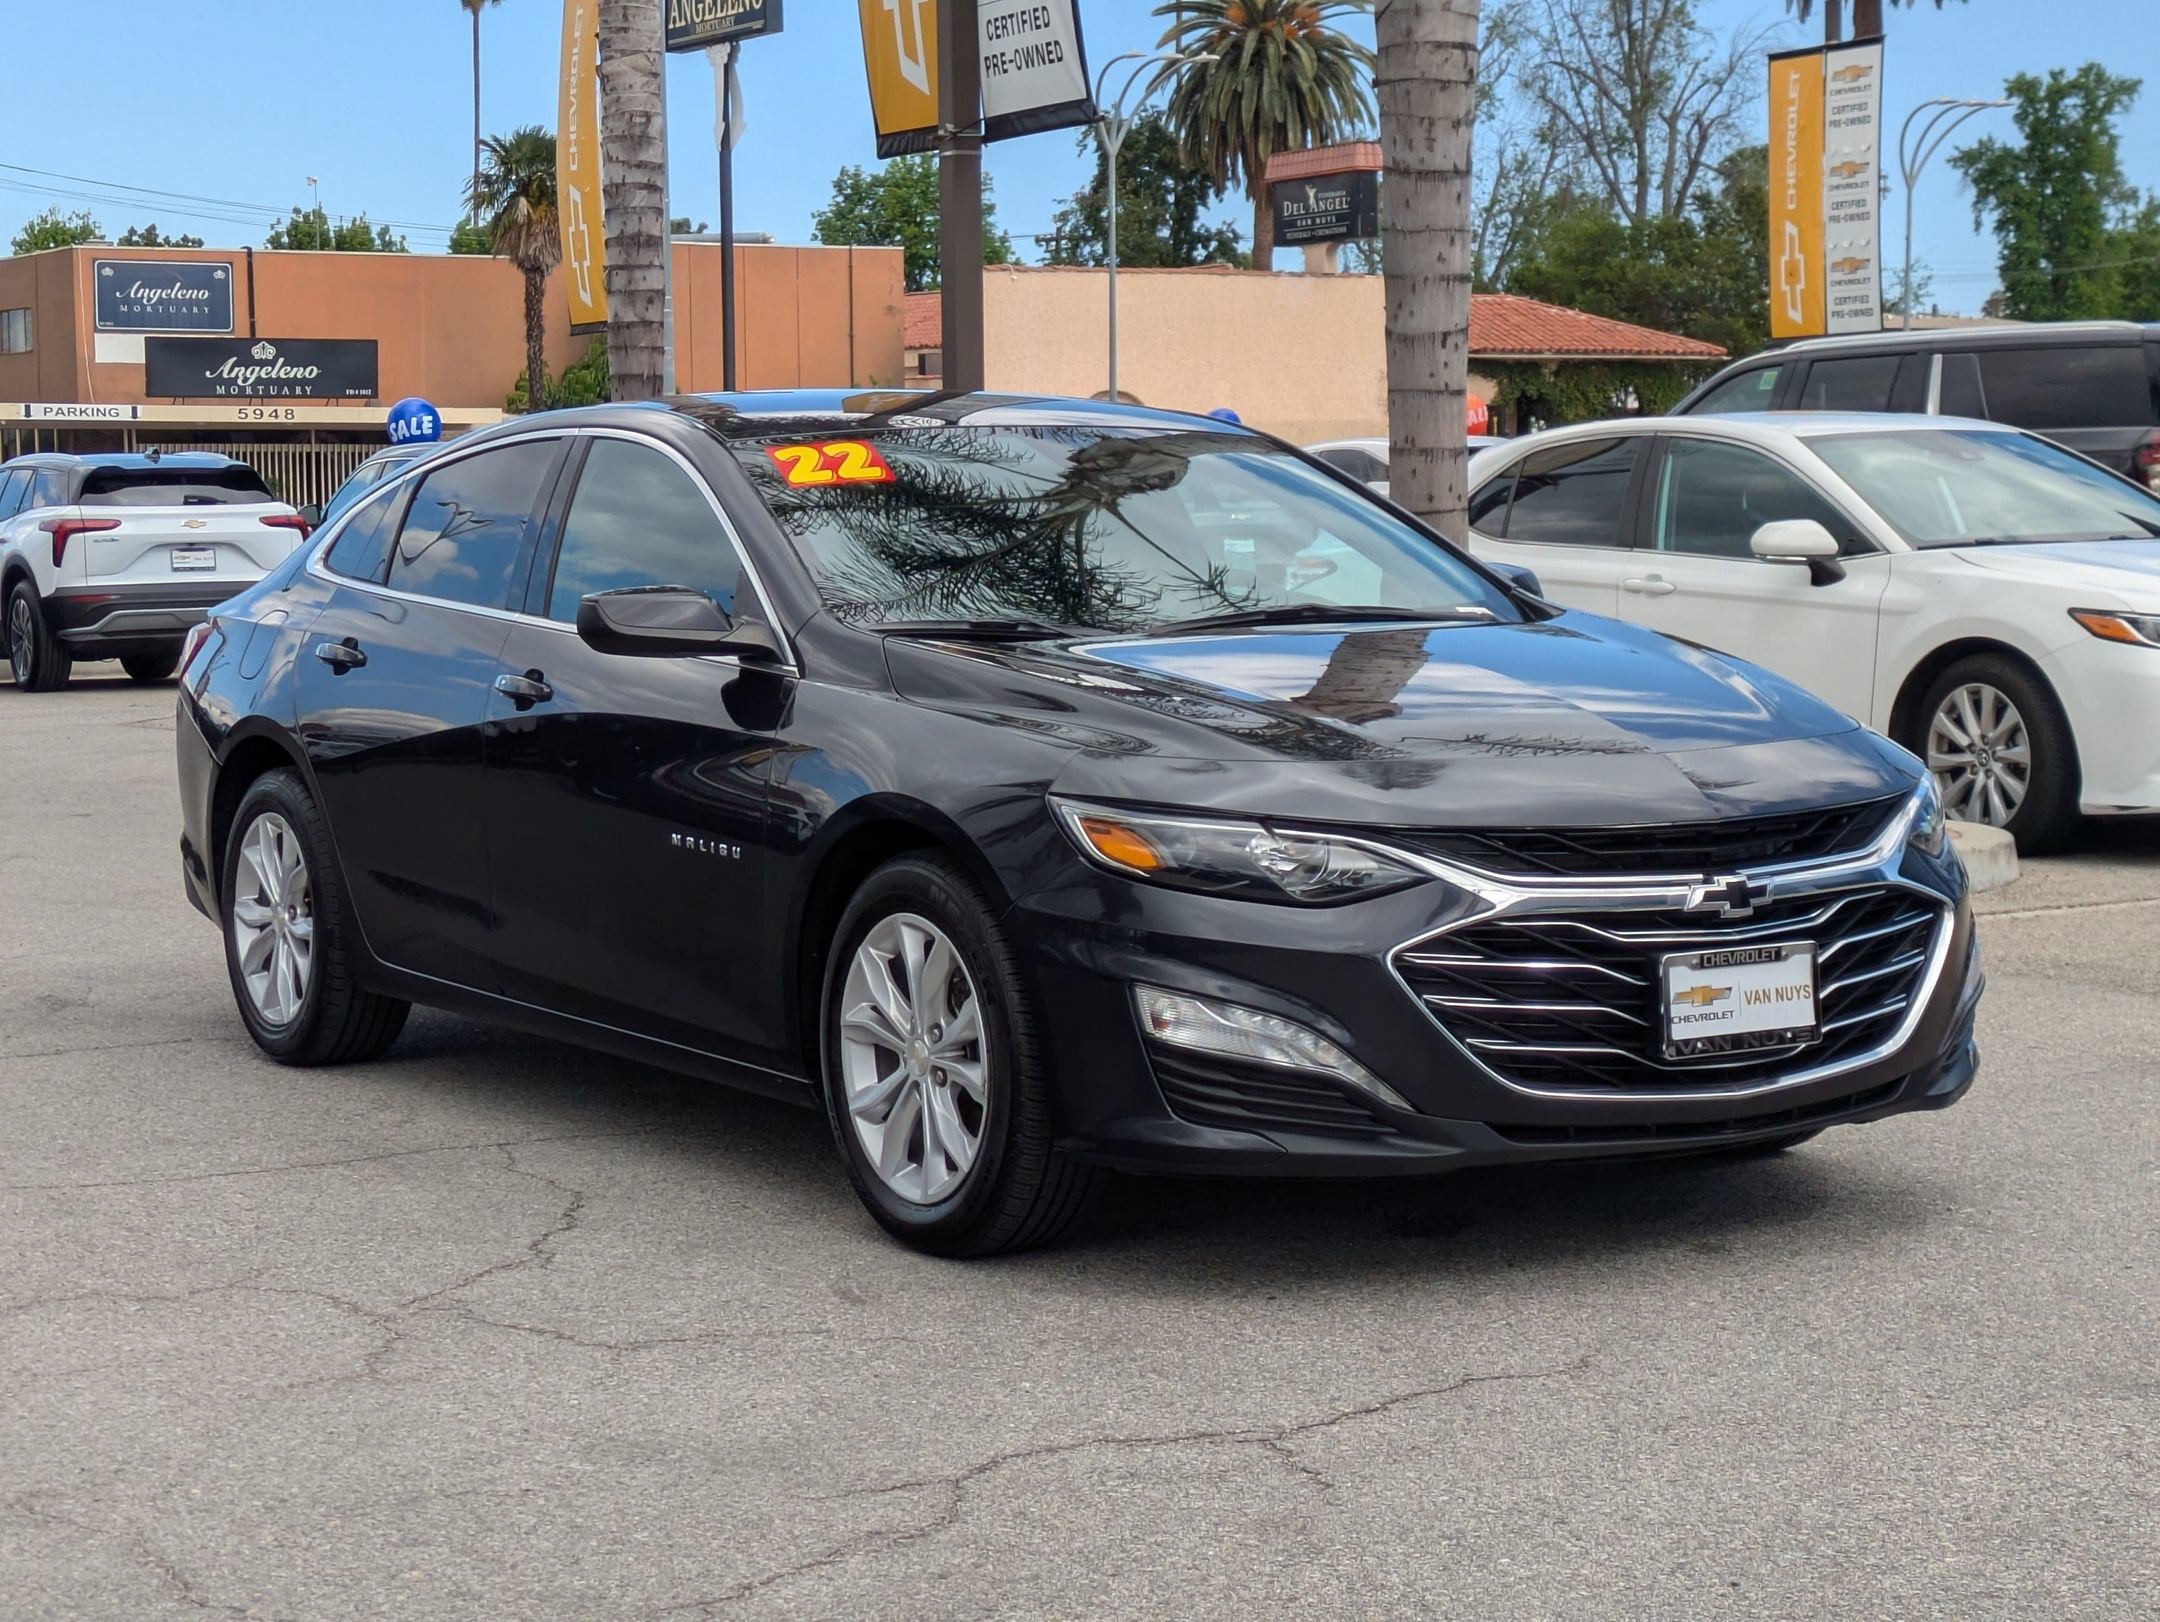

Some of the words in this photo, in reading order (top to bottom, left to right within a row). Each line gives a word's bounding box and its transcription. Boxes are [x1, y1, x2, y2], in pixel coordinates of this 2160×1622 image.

[668, 0, 763, 29] ANGEL
[986, 5, 1051, 41] CERTIFIED
[695, 15, 736, 34] MORTUARY
[984, 39, 1064, 78] PRE-OWNED
[569, 5, 585, 171] CHEVROLET
[1831, 102, 1869, 115] CERTIFIED
[1828, 115, 1872, 128] PRE-OWNED
[1786, 70, 1801, 210] CHEVROLET
[1831, 199, 1867, 211] CERTIFIED
[1828, 211, 1871, 224] PRE-OWNED
[116, 280, 210, 305] Angeleno
[1833, 294, 1870, 306] CERTIFIED
[120, 304, 210, 315] MORTUARY
[1831, 307, 1874, 319] PRE-OWNED
[205, 356, 322, 386] Angeleno
[216, 385, 313, 396] MORTUARY
[43, 406, 120, 418] PARKING
[238, 408, 296, 420] 5948
[389, 415, 433, 443] SALE
[774, 442, 887, 485] 22
[671, 833, 741, 859] MALIBU
[1703, 948, 1778, 967] CHEVROLET
[1744, 988, 1772, 1006] VAN
[1775, 984, 1812, 1003] NUYS
[1671, 1010, 1735, 1025] CHEVROLET
[1677, 1036, 1732, 1055] VAN
[1744, 1028, 1814, 1049] NUYS
